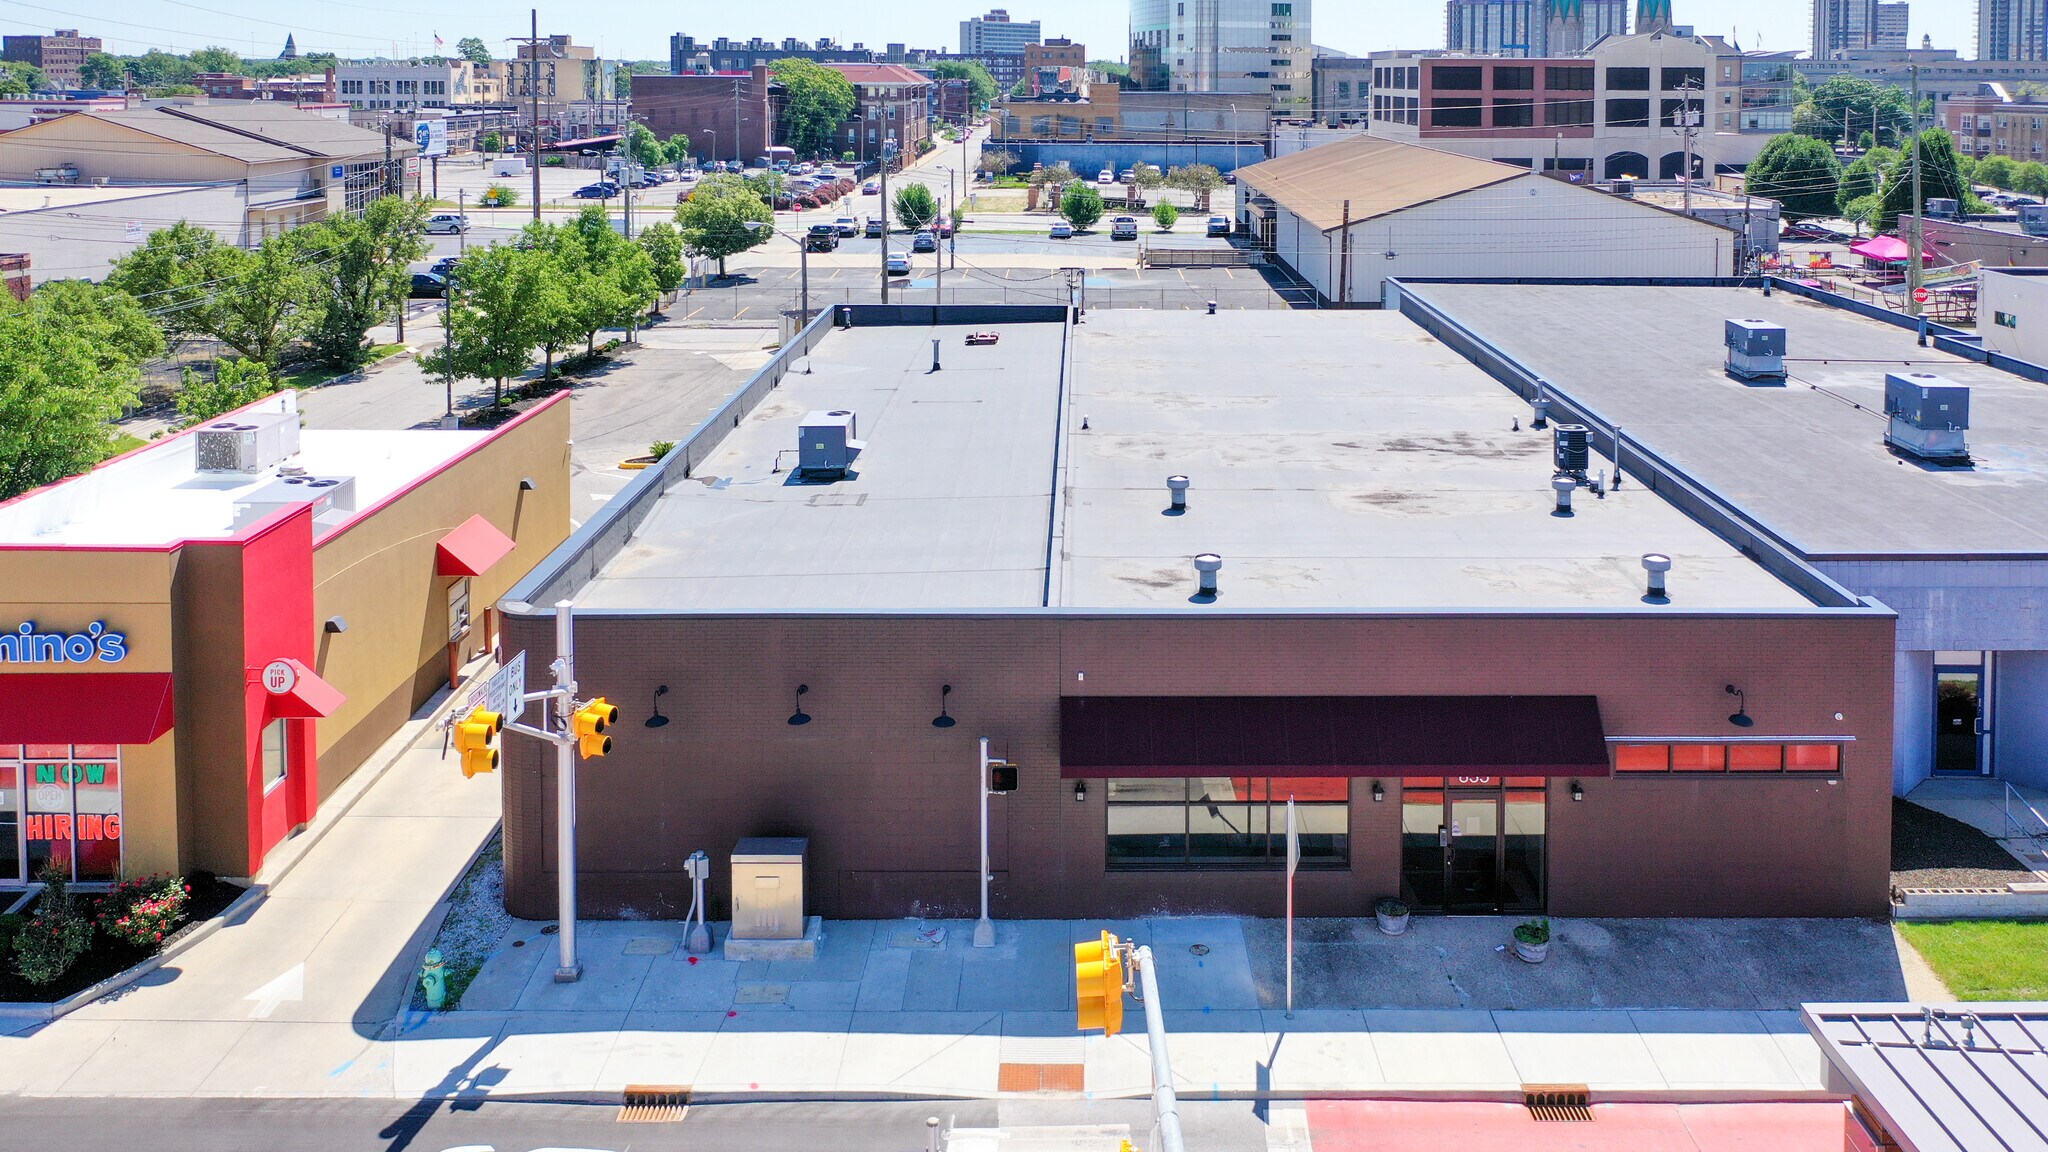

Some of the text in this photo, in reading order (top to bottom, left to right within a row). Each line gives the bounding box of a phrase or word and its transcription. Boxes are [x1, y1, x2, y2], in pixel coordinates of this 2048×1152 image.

[511, 660, 521, 678] BUS
[271, 677, 285, 688] UP
[509, 677, 523, 696] ONLY
[36, 764, 105, 784] NOW
[38, 790, 60, 799] OPEN
[27, 814, 120, 840] HIRING
